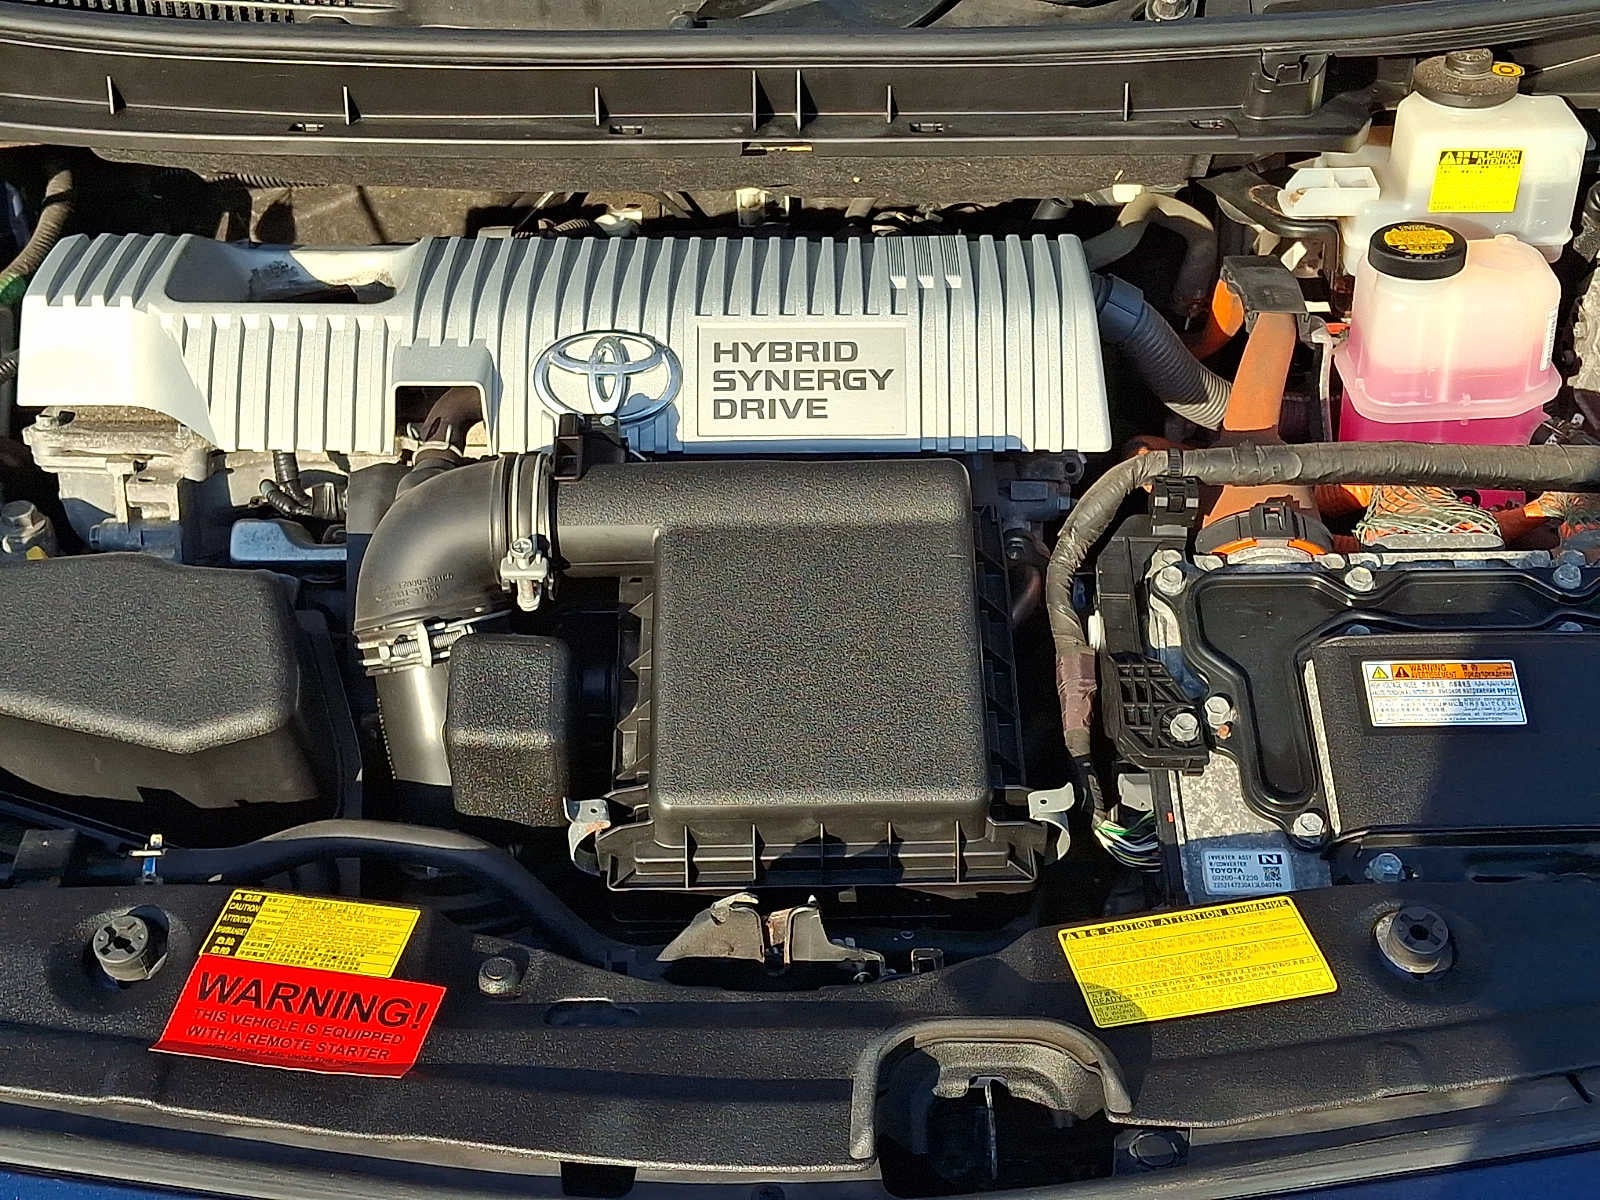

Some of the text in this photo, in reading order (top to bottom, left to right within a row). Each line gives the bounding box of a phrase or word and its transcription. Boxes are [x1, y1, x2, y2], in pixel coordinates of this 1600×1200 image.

[714, 341, 858, 363] HYBRID
[713, 368, 894, 391] SYNERGY
[713, 398, 828, 419] DRIVE
[1410, 663, 1447, 671] WARNING
[229, 902, 261, 912] CAUTION
[222, 913, 255, 924] ATTENTION
[1105, 920, 1154, 934] CAUTION
[1160, 909, 1222, 926] ATTENTION
[199, 971, 428, 1029] WARNING!
[1093, 994, 1122, 1006] READY
[195, 1007, 403, 1044] THIS VEHICLE IS EQUIPPED
[187, 1024, 227, 1041] WITH
[227, 1028, 240, 1042] A
[245, 1031, 312, 1050] REMOTE
[317, 1041, 390, 1060] STARTER
